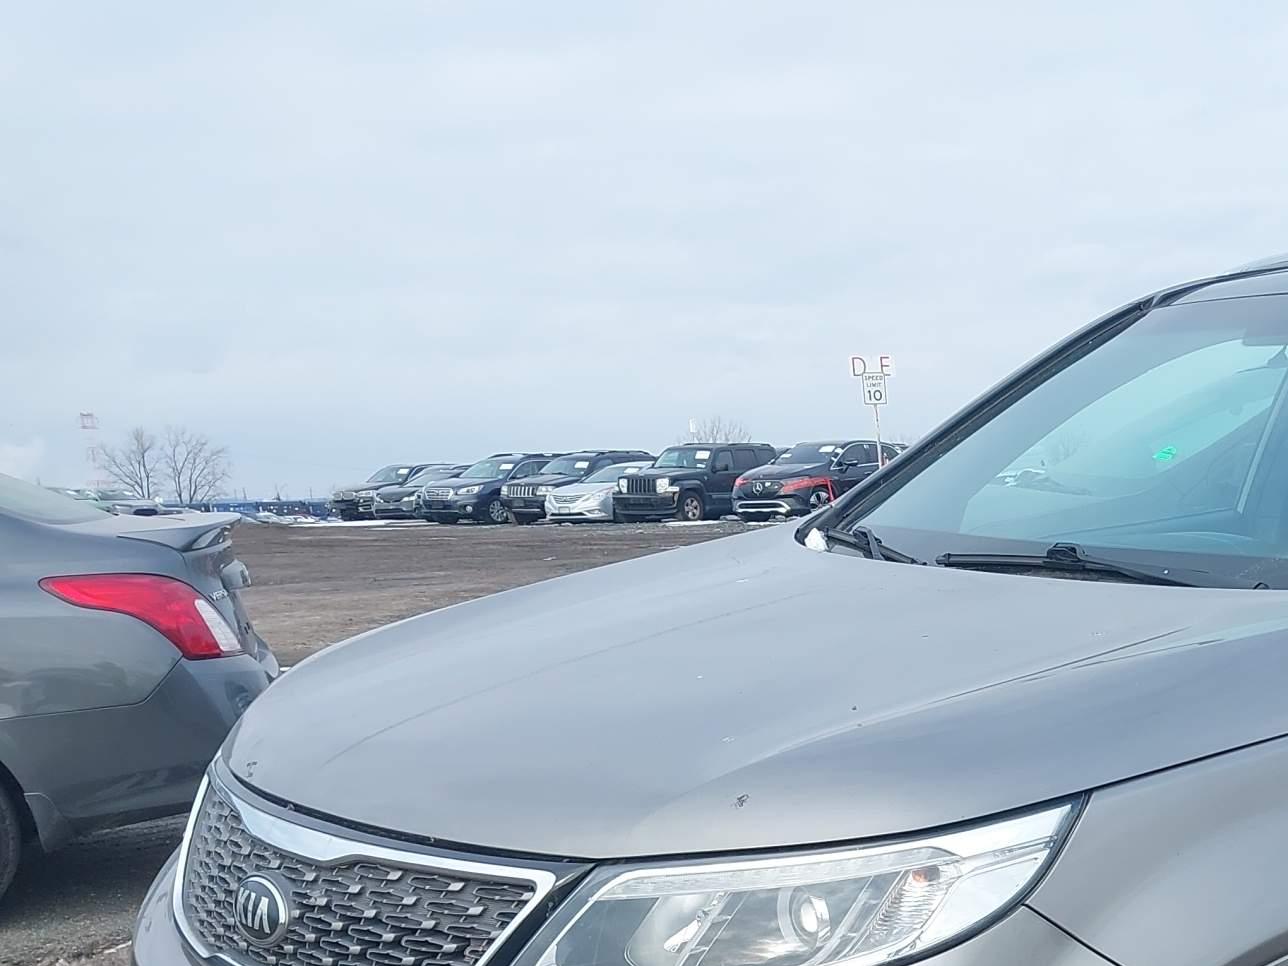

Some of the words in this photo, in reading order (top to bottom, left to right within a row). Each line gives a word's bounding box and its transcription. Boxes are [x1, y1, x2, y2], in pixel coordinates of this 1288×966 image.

[851, 356, 867, 376] D
[879, 356, 891, 376] E
[867, 389, 883, 401] 10
[237, 886, 270, 934] KIA
